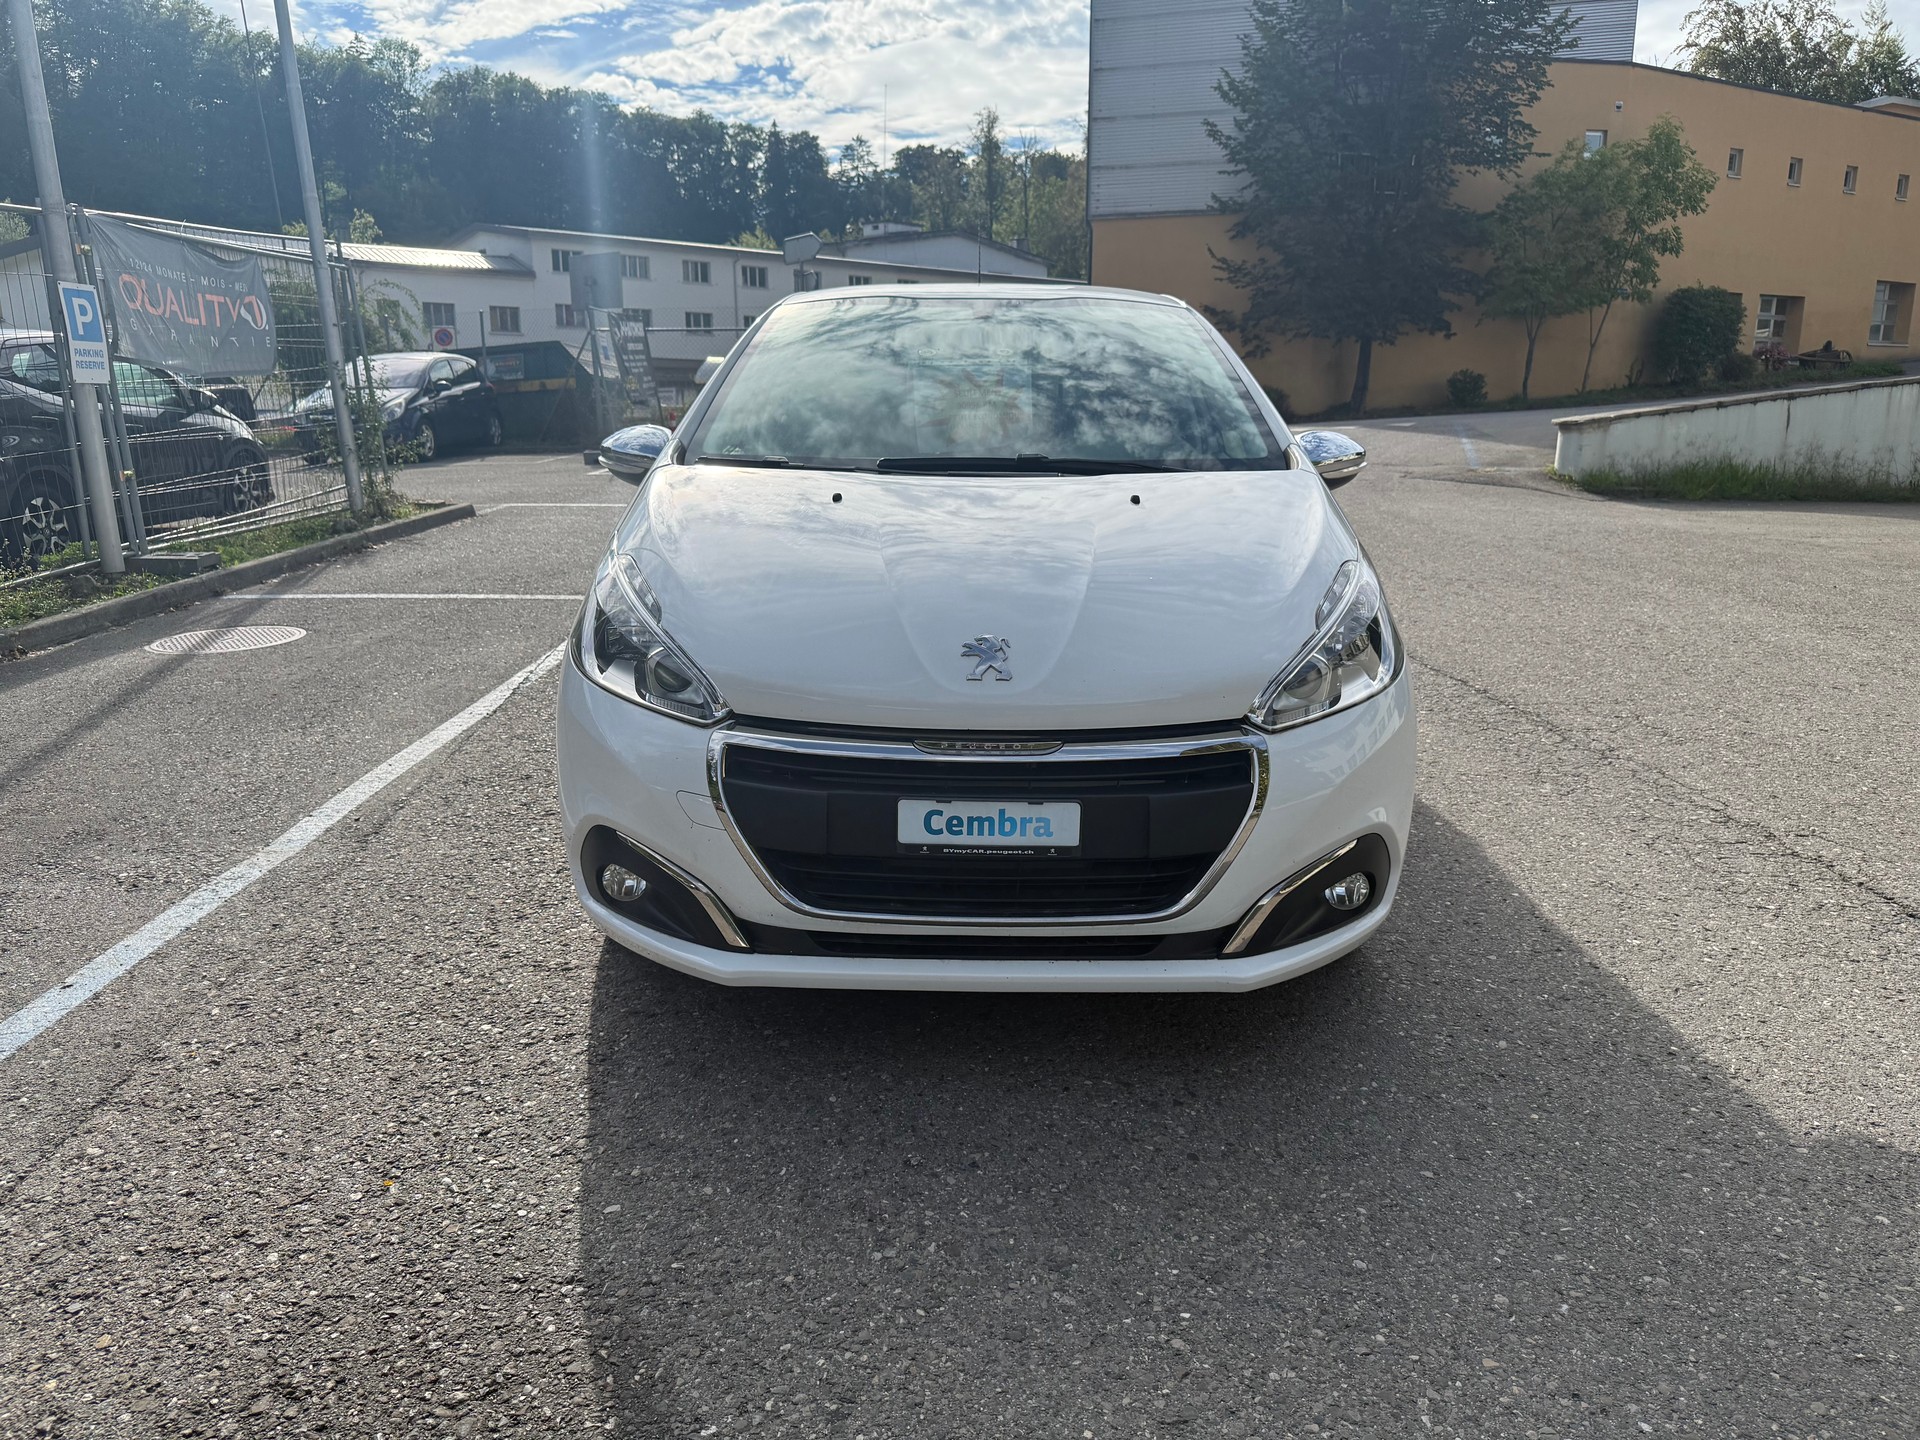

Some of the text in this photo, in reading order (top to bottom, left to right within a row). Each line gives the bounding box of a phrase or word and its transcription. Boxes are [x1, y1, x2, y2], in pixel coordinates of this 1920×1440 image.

[156, 265, 187, 282] MONATE
[201, 276, 226, 288] MOIS
[71, 297, 93, 335] P
[74, 348, 104, 358] PARKING
[75, 360, 105, 370] RESERVE
[923, 808, 1054, 838] Cembra
[943, 847, 1034, 855] BYmyCAR.peugeot.ch
